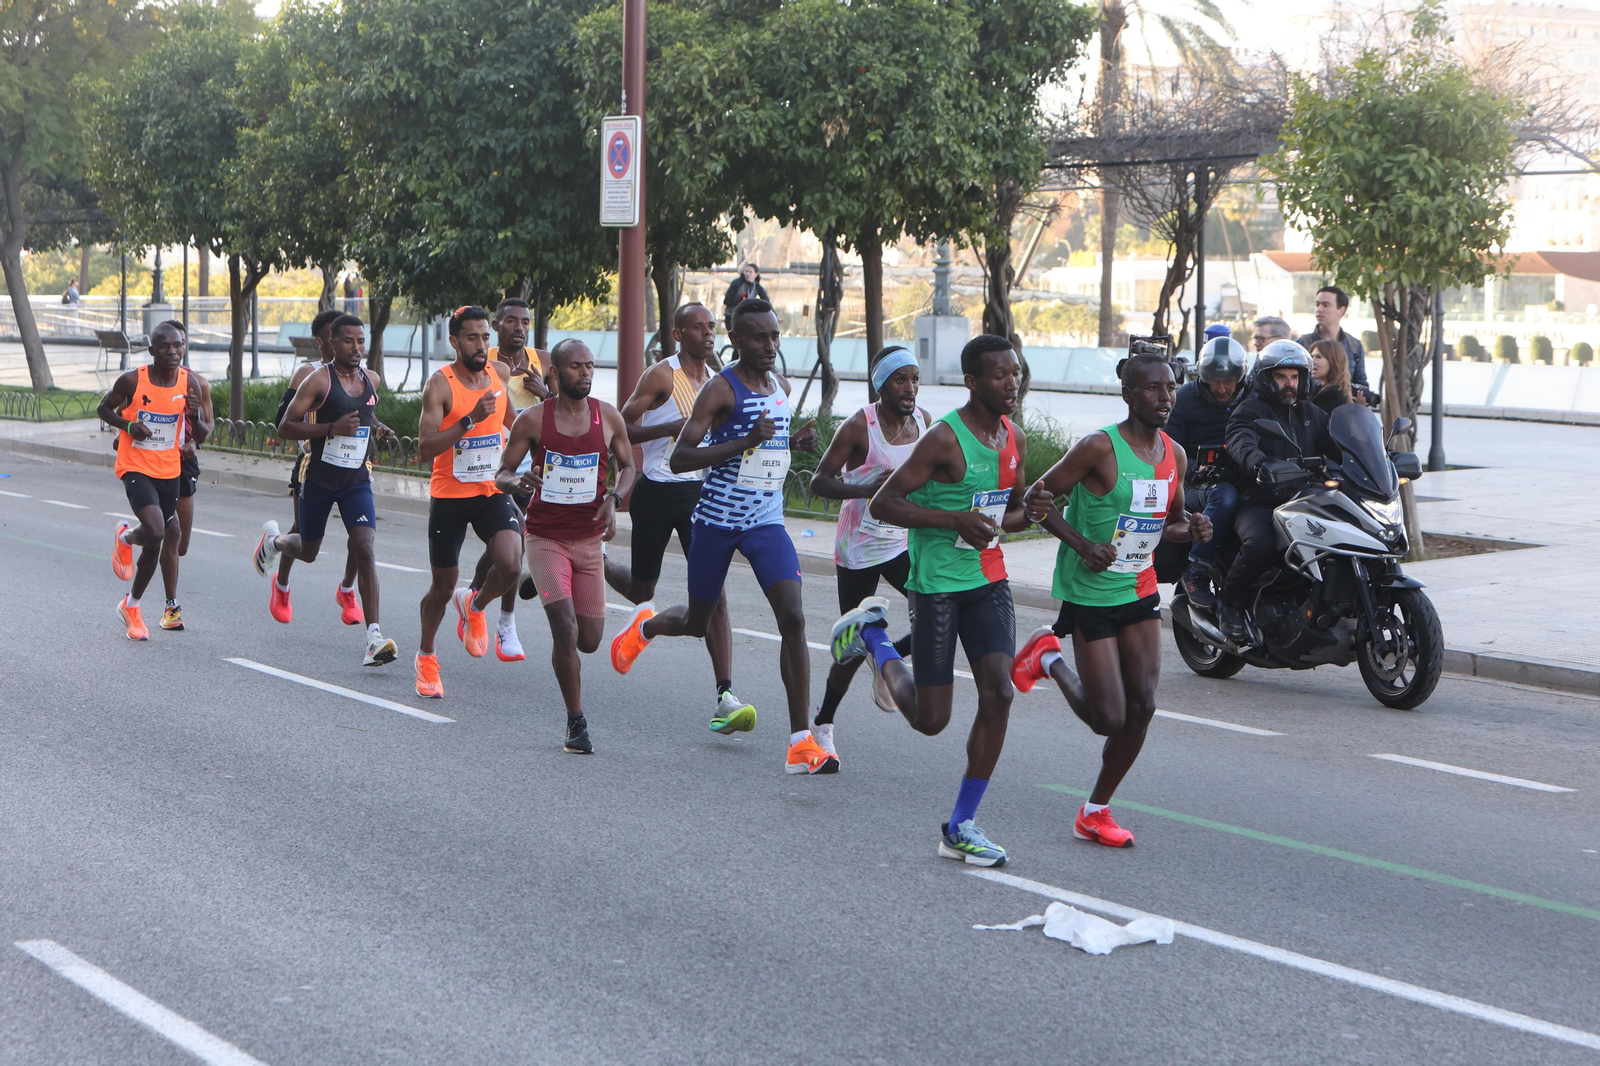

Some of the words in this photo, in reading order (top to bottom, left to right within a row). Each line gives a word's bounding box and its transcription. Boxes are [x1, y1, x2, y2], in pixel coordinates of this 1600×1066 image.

[472, 438, 497, 447] ZURICH
[477, 454, 482, 462] 5
[565, 457, 592, 467] ZURICH
[559, 476, 586, 484] HIYRDEN
[1148, 484, 1157, 497] 36
[1138, 541, 1148, 549] 36
